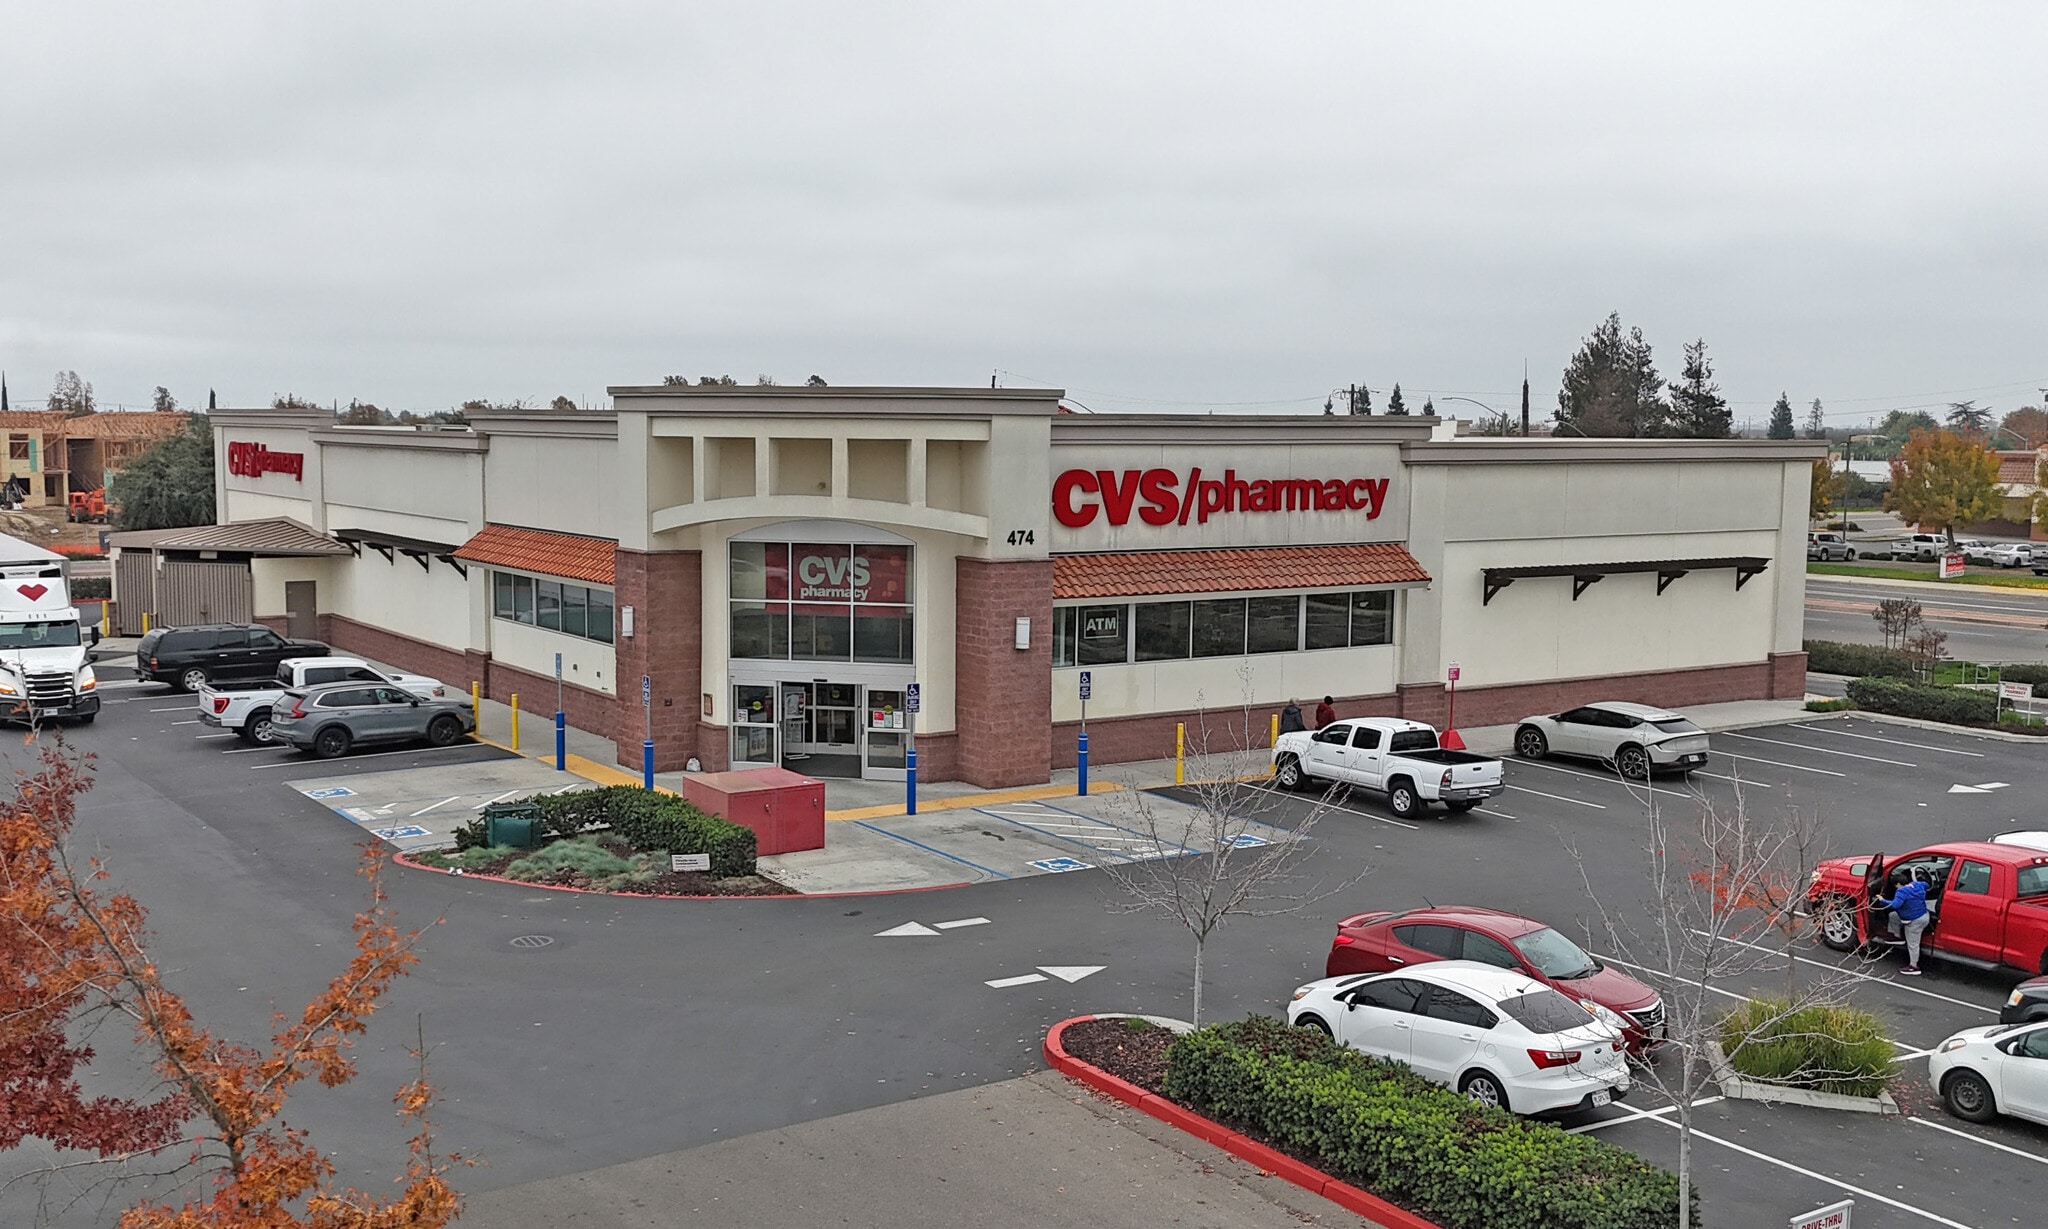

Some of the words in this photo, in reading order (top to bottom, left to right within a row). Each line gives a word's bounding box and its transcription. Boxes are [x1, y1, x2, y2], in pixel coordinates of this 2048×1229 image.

[1051, 467, 1390, 528] CVS/pharmacy
[1007, 530, 1035, 546] 474
[799, 556, 871, 587] CVS
[800, 585, 869, 601] pharmacy
[1086, 617, 1116, 631] ATM
